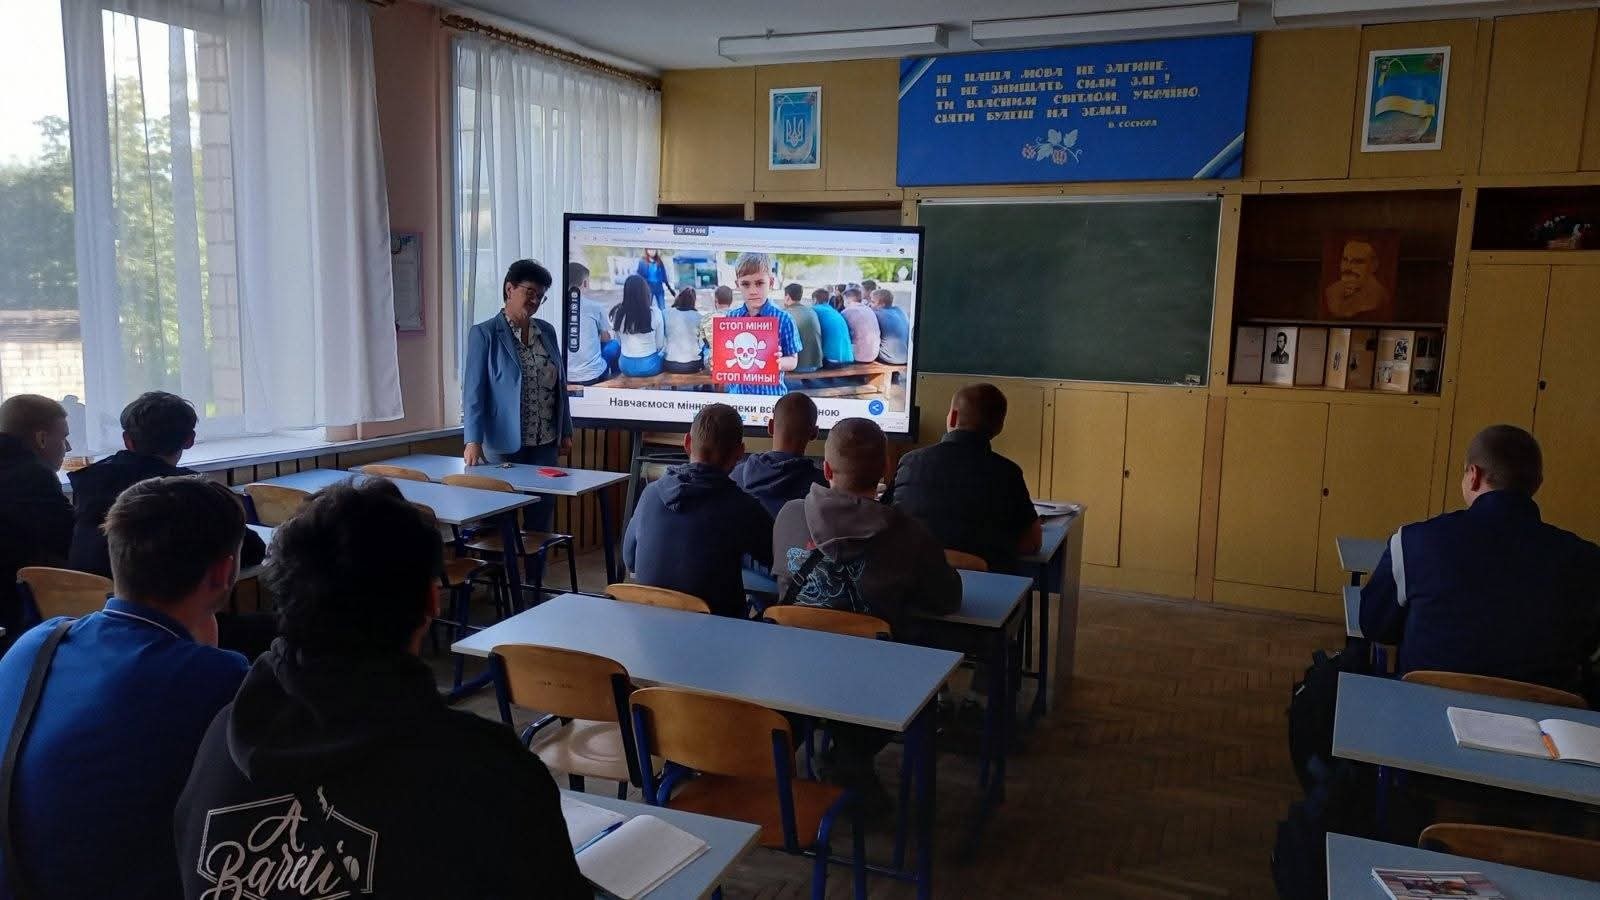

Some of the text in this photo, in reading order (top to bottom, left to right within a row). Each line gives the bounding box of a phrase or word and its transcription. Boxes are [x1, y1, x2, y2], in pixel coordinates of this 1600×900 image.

[965, 71, 1011, 82] НАША
[1021, 68, 1063, 78] МОВА
[1076, 65, 1096, 76] НЕ
[1076, 78, 1117, 89] СИЛИ
[936, 100, 955, 110] ТИ
[967, 97, 1037, 108] ВЛАСНИМ
[1047, 108, 1068, 118] НА
[719, 321, 773, 331] СТОП МІНИ!
[715, 372, 776, 384] СТОП МИНЫ!
[609, 397, 675, 409] Навчаємося
[677, 401, 711, 411] мінно
[247, 799, 309, 853] A
